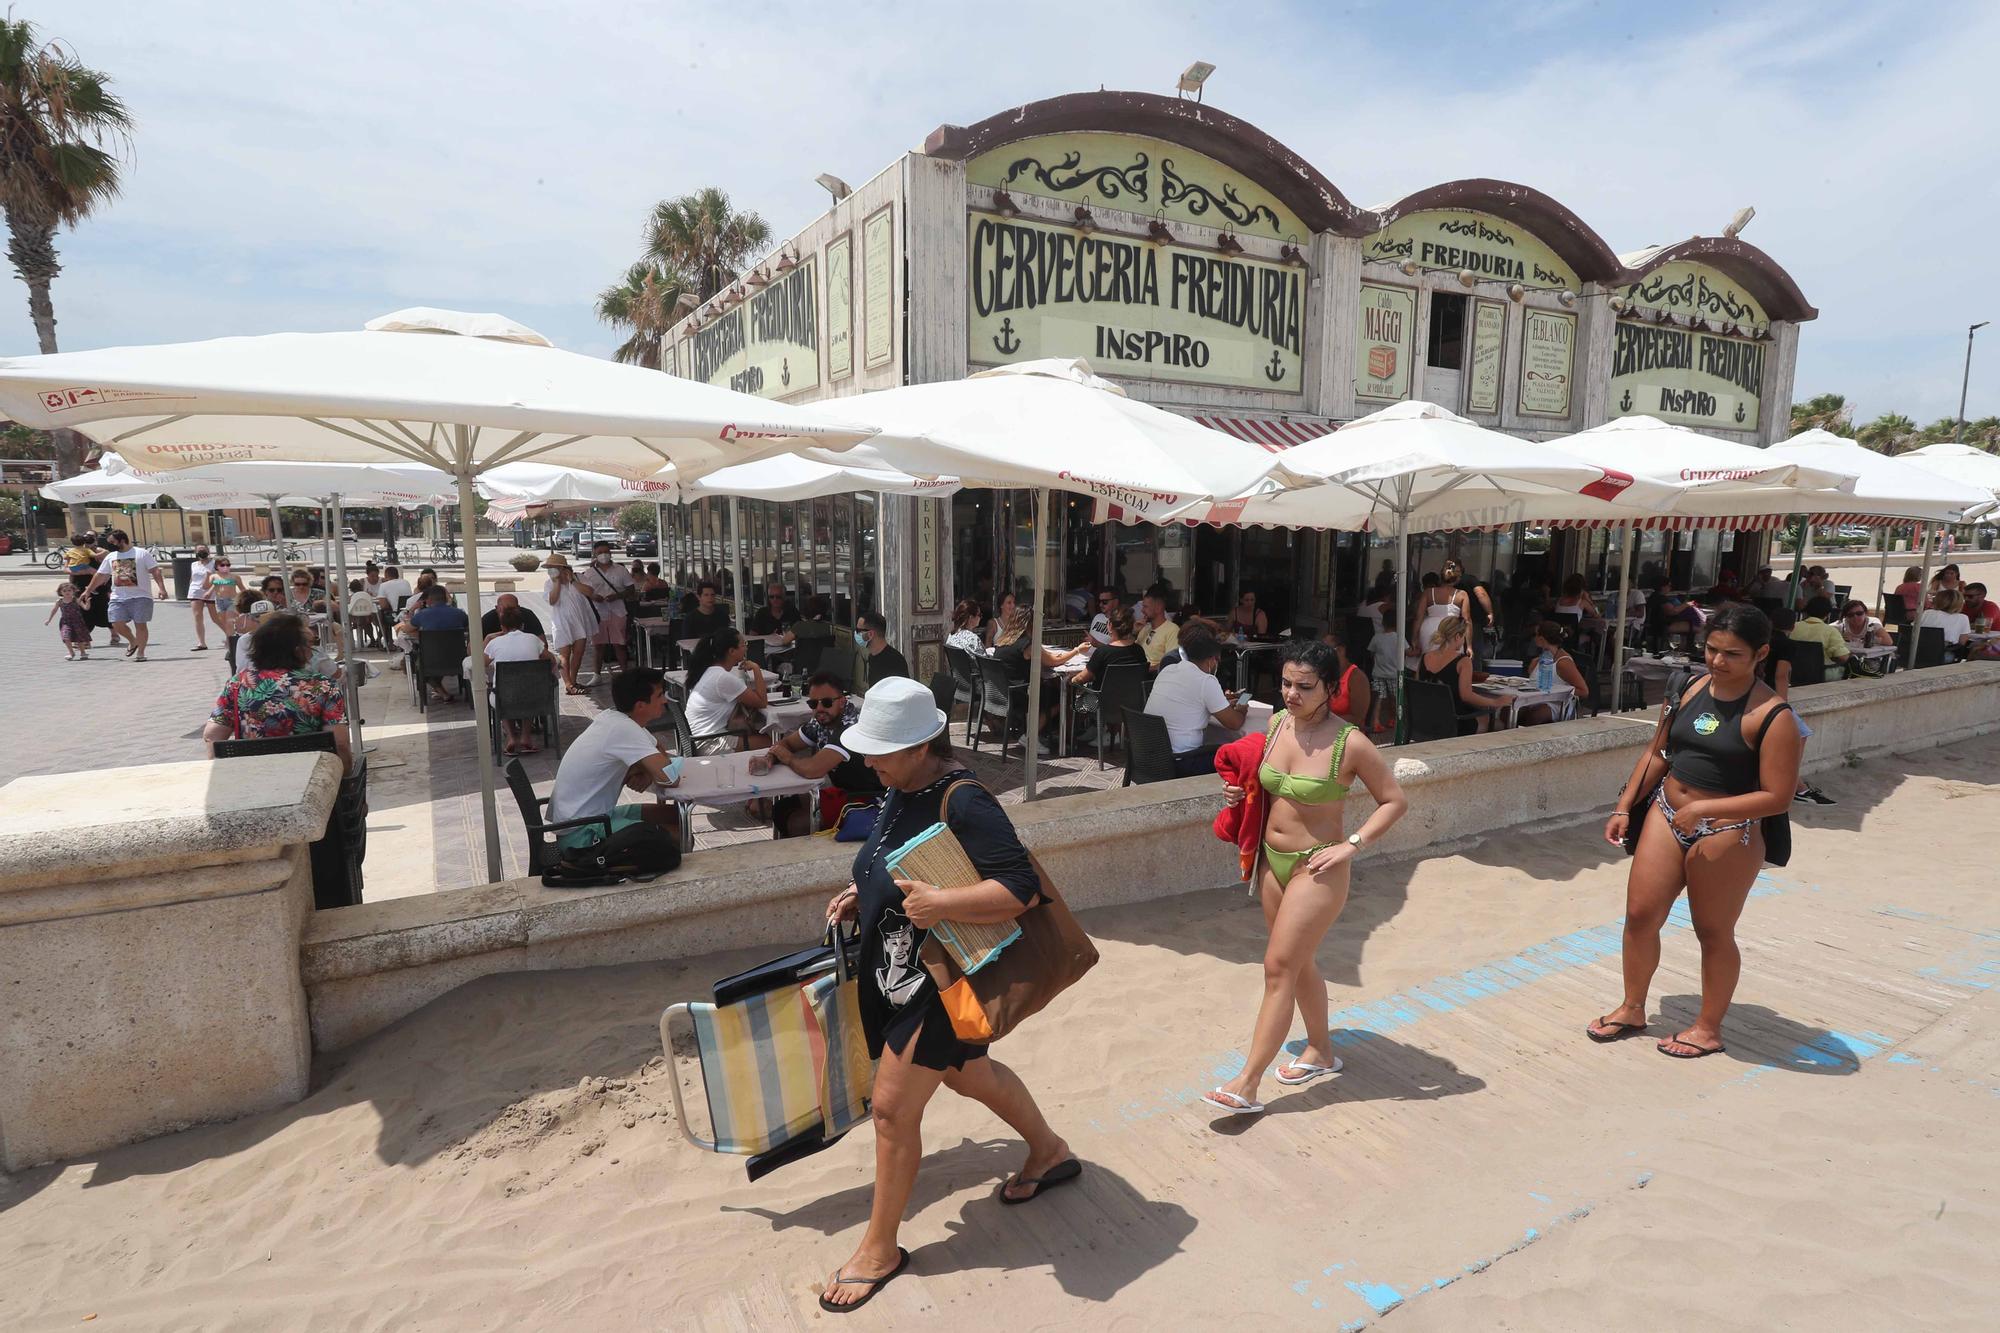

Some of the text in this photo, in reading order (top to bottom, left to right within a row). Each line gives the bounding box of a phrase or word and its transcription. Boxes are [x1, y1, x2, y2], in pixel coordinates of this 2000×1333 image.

[1421, 241, 1525, 280] FREIDURIA
[973, 217, 1160, 317] CERVECERIA
[1171, 252, 1301, 356] FREIDURIA
[1363, 307, 1402, 344] MAGGI
[1532, 318, 1569, 345] H.BLANCO
[1095, 325, 1210, 368] INSPIRO
[1699, 336, 1761, 399] FREIDURIA
[1659, 387, 1717, 417] INSPIRO
[1090, 481, 1149, 513] ESPECIAL
[923, 499, 933, 597] ERVEZA
